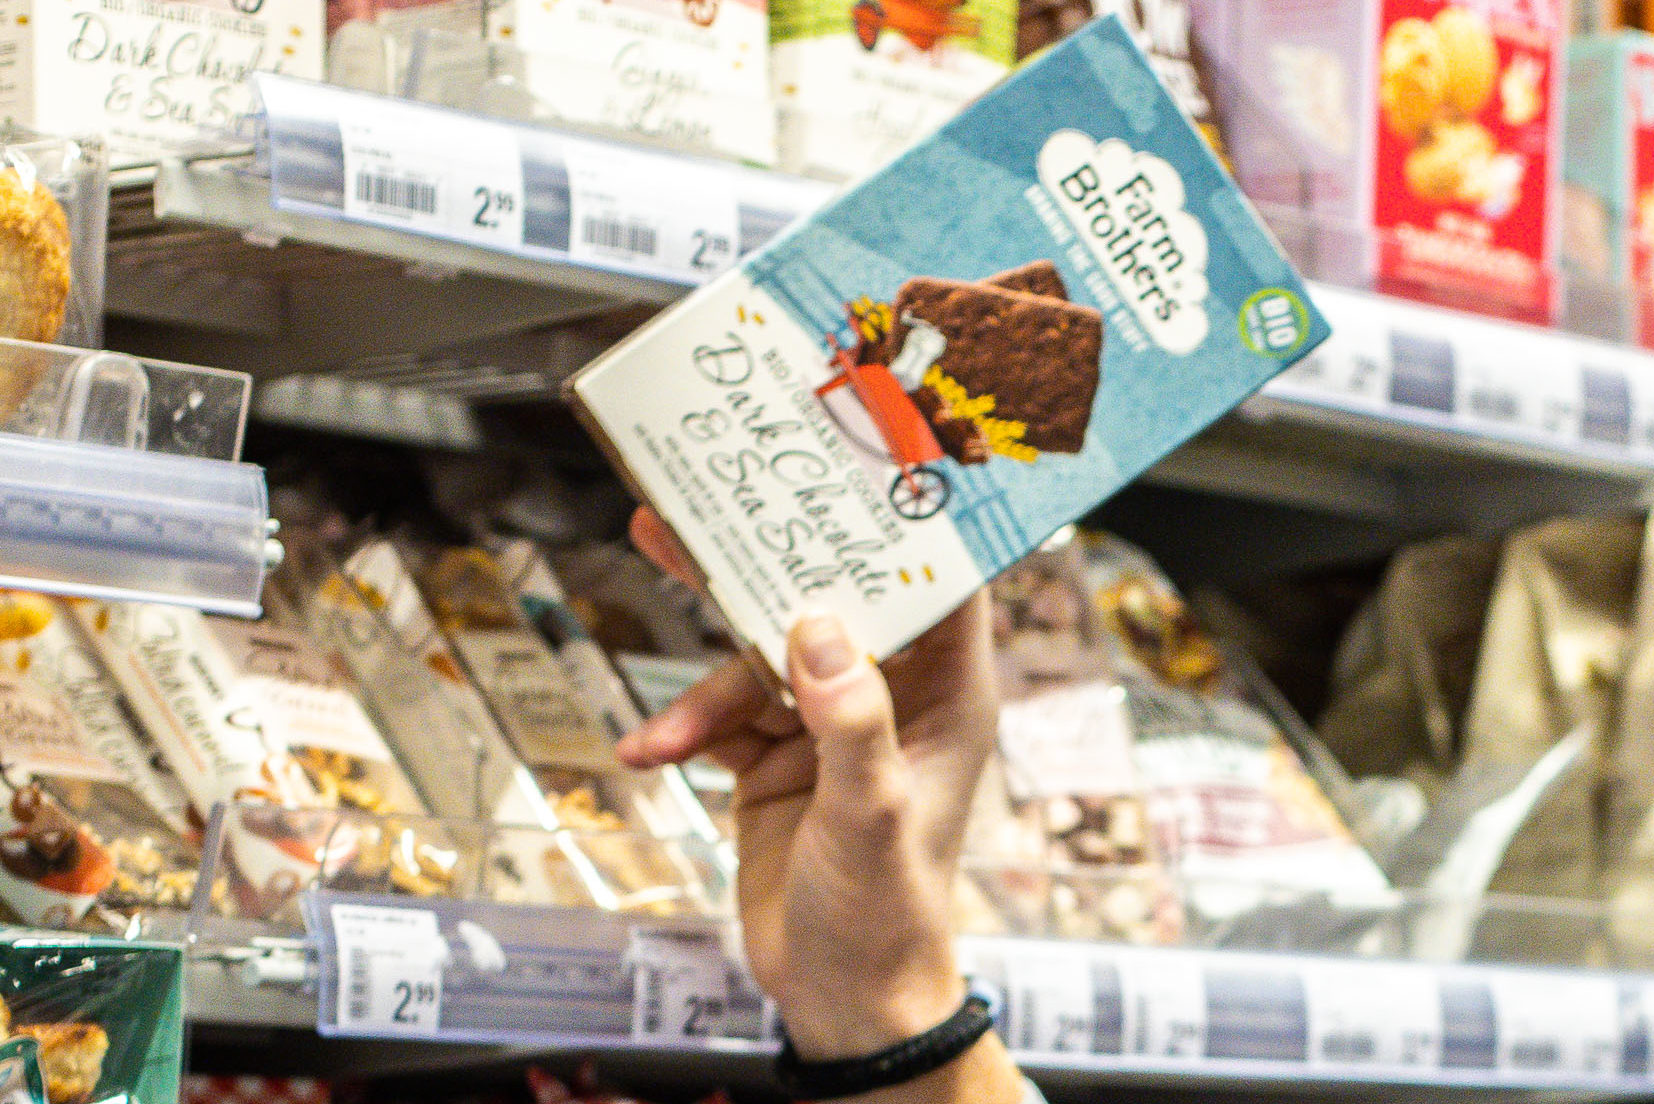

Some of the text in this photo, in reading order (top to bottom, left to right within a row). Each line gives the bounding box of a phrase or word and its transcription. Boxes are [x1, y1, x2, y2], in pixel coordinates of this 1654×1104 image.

[1058, 162, 1183, 323] Brothers
[1116, 171, 1186, 274] Farm
[1260, 296, 1297, 347] BIO
[680, 407, 843, 597] & Sea Salt
[693, 331, 803, 449] Dark
[769, 450, 890, 603] Chocolate
